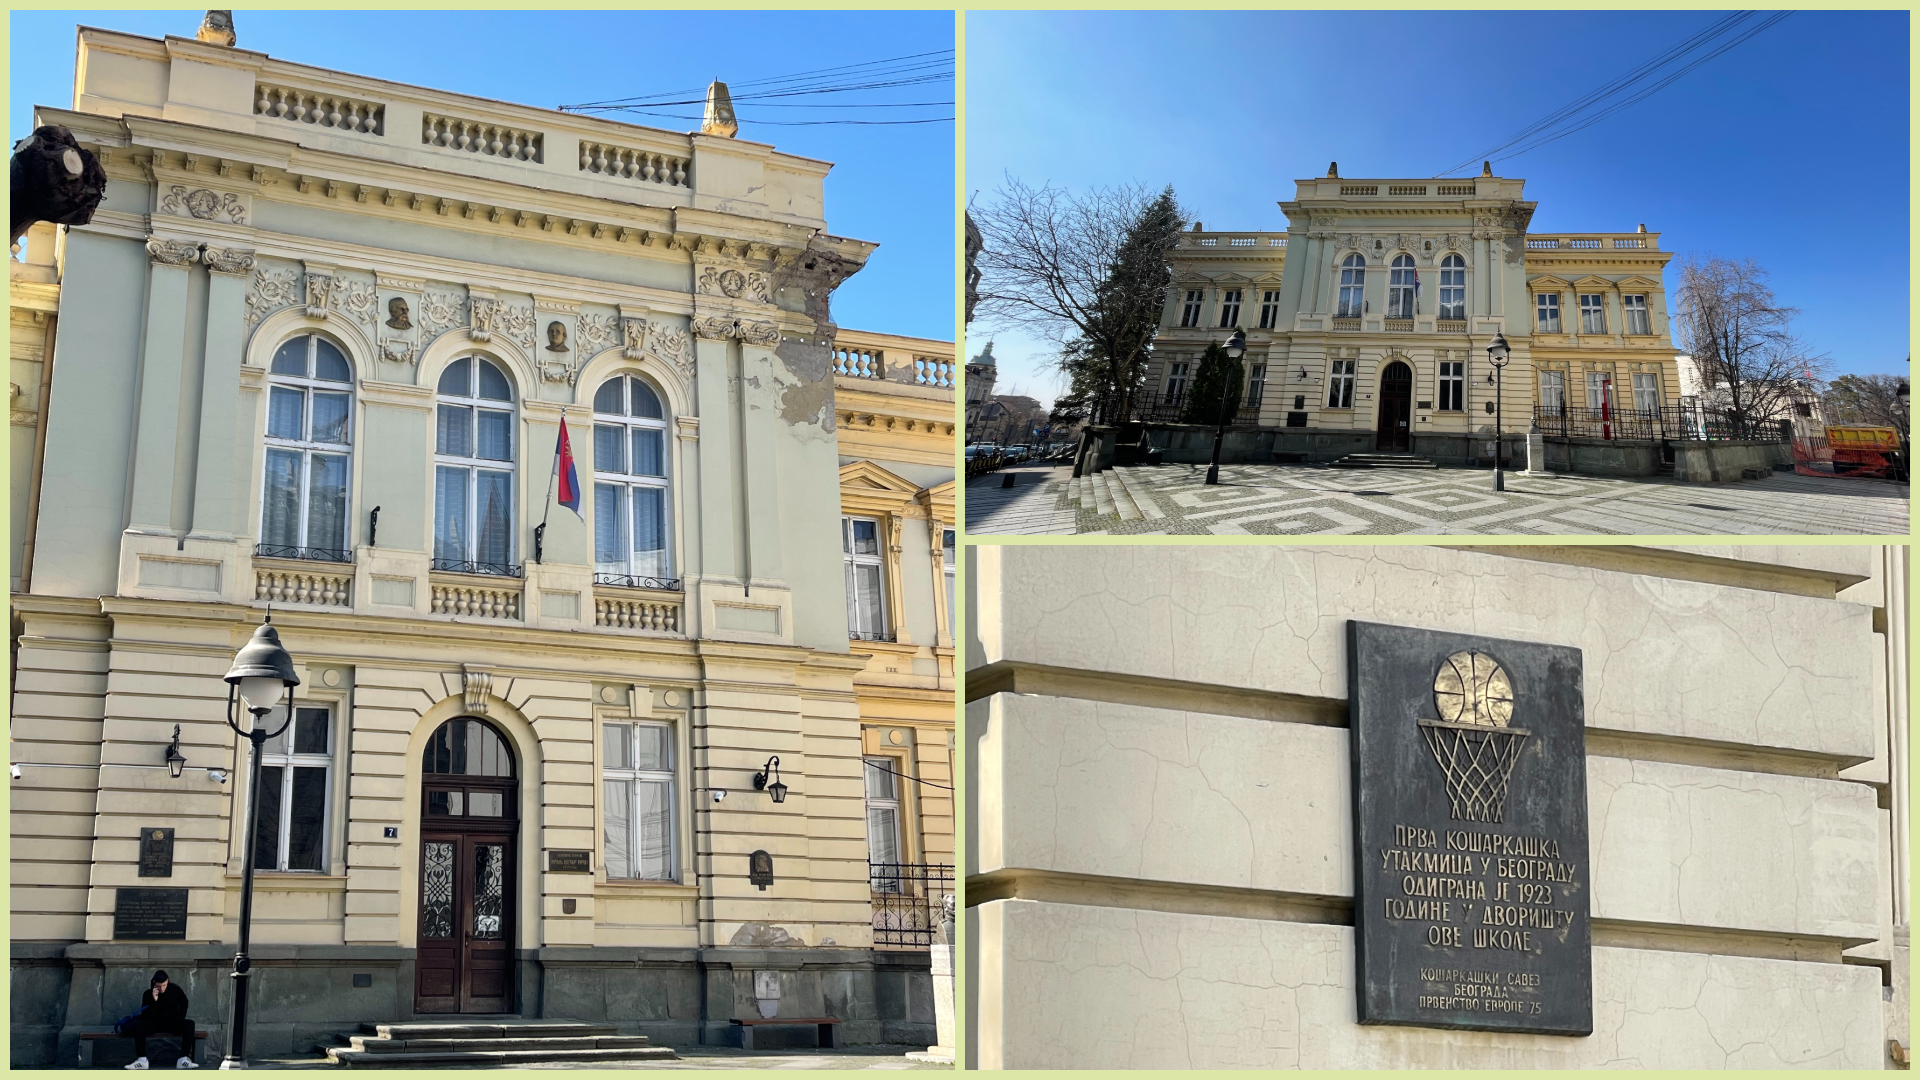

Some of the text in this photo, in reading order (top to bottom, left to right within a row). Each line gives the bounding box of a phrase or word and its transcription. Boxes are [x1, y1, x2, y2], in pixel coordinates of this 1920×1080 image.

[388, 828, 394, 837] 7
[1395, 824, 1560, 859] ПРВА КОШАРКАШКА
[1381, 849, 1576, 883] УТАКМИЦА У БЕОГРАДУ
[1403, 875, 1552, 905] ОДИГРАНА ЈЕ 1923
[1385, 898, 1575, 929] ГОДИНЕ У ДВОРИШТУ
[1428, 925, 1531, 951] ОВЕ ШКОЛЕ
[1420, 968, 1540, 986] КОШАРКАШКИ САВЕЗ
[1419, 995, 1480, 1011] ПРВЕНСТВО
[1485, 999, 1524, 1013] ЕВРОПЕ
[1454, 983, 1508, 999] БЕОГРАДА
